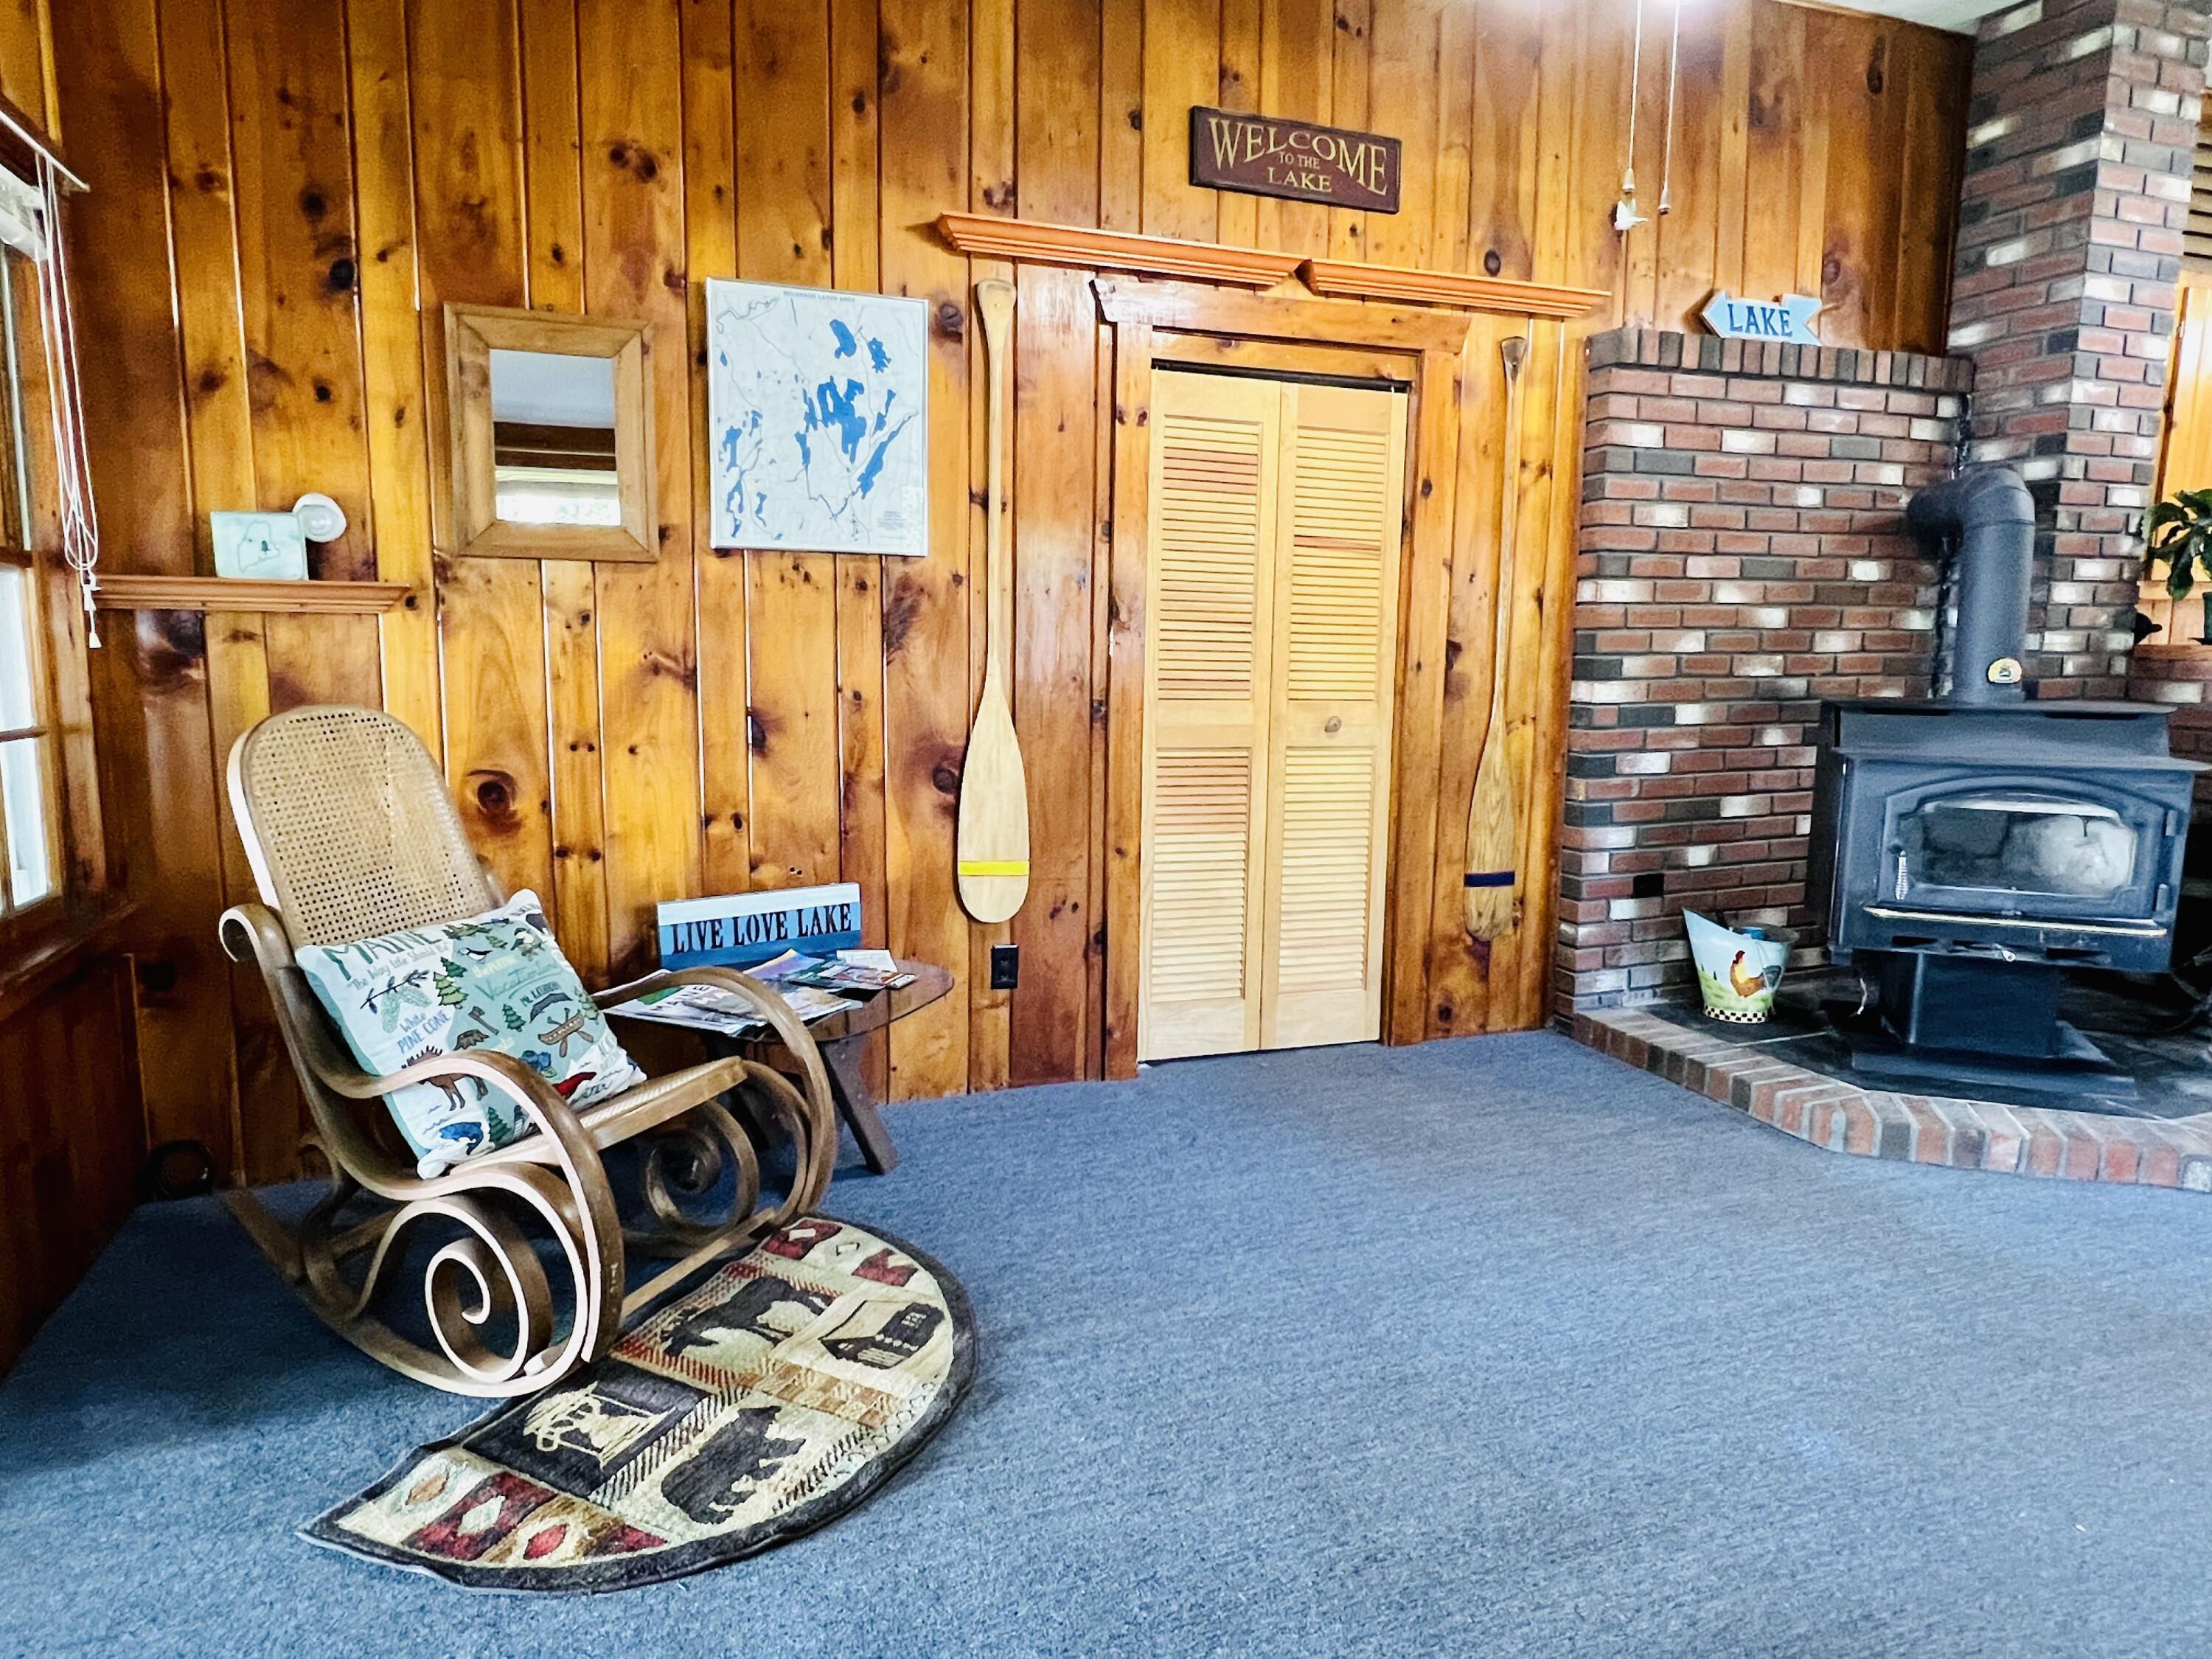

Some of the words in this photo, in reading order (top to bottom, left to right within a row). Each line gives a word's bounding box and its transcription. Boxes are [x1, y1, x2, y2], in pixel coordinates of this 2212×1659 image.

[1208, 117, 1388, 196] WELCOME
[1278, 151, 1294, 164] TO
[1297, 154, 1321, 170] THE
[1267, 167, 1332, 193] LAKE
[1727, 303, 1793, 338] LAKE
[671, 919, 723, 955] LIVE
[731, 911, 789, 947] LOVE
[796, 902, 852, 938] LAKE
[321, 931, 442, 981] MAINE
[397, 1029, 425, 1054] PINE
[422, 1009, 452, 1035] CONE
